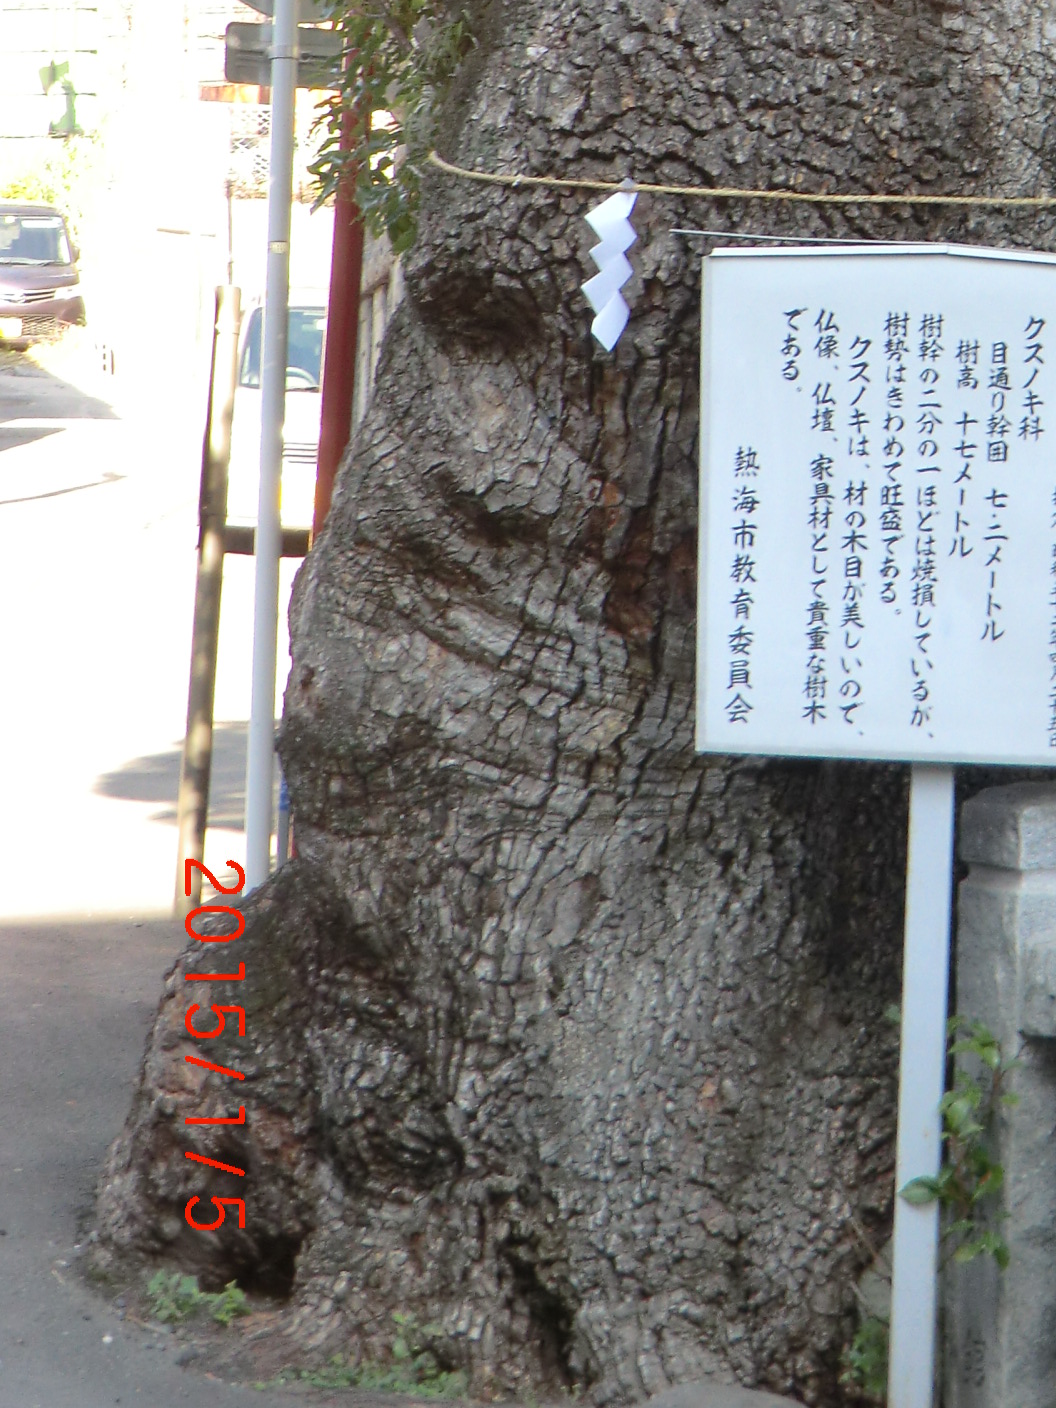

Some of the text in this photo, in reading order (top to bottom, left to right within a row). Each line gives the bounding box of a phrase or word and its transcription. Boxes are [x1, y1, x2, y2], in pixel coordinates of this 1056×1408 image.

[781, 307, 809, 393] である。
[879, 312, 911, 615] 樹勢はきわめて旺盛である。
[948, 340, 980, 558] 樹高 十七メートル
[986, 341, 1012, 463] 目通り幹囲
[1018, 315, 1046, 441] クスノキ科
[724, 446, 760, 724] 熱海市教育委員会
[802, 308, 840, 725] 仏像、仏壇、家具材として貴重な樹木
[839, 336, 873, 736] クスノキは、材の木目が美しいので、
[910, 313, 945, 738] 樹幹の二分の一ほどは焼損しているが、
